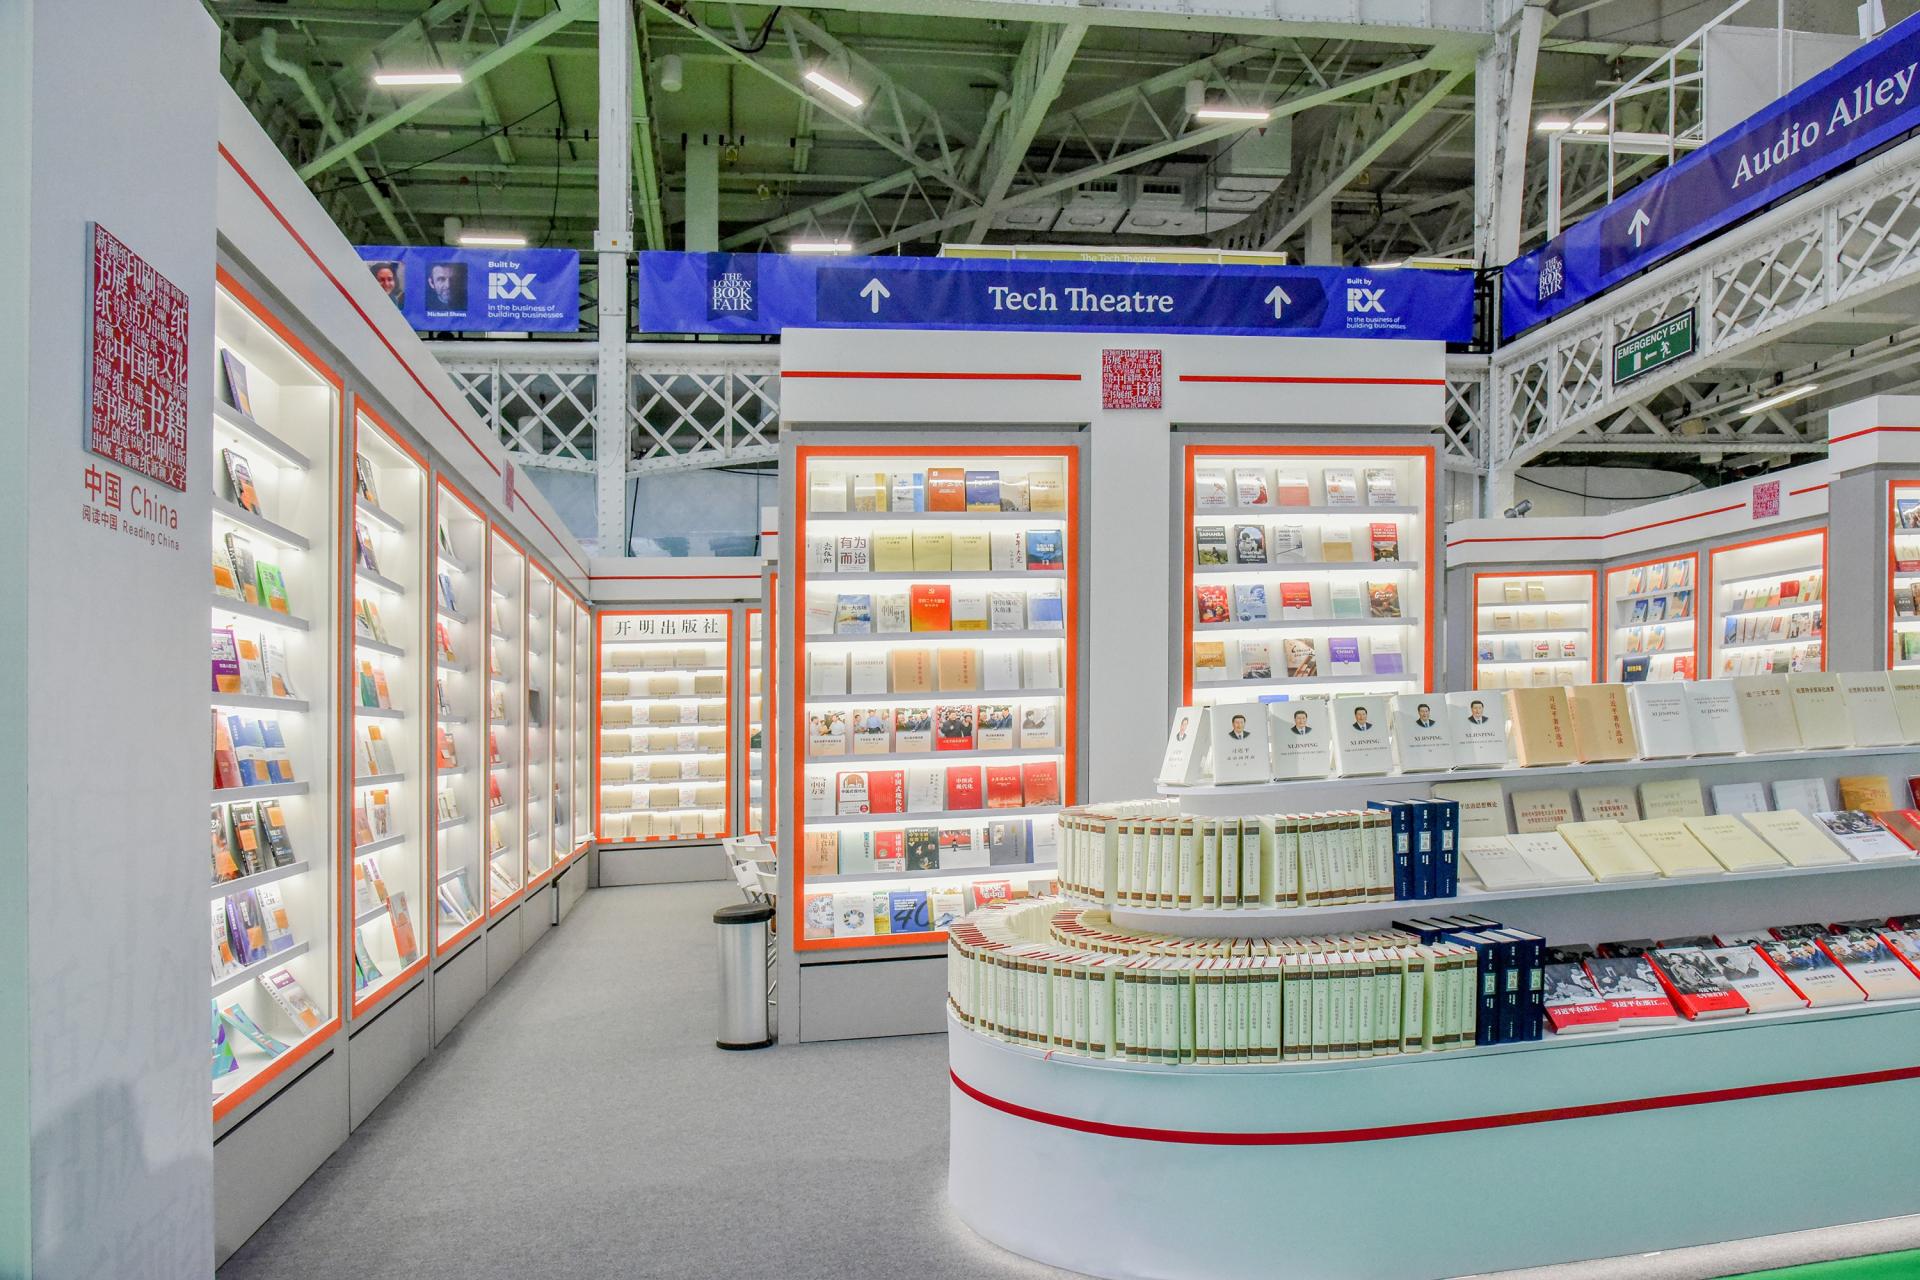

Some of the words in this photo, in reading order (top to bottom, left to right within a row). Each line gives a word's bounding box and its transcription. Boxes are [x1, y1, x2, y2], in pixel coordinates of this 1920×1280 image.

[1731, 121, 1820, 189] Audio
[1826, 62, 1919, 136] Alley
[509, 261, 520, 270] by
[488, 272, 537, 300] RX
[713, 280, 751, 288] LONDON
[722, 272, 742, 281] THE
[1363, 278, 1372, 286] by
[713, 287, 752, 299] BOOK
[988, 286, 1058, 311] Tech
[1065, 287, 1174, 313] Theatre
[1347, 288, 1386, 313] RX
[488, 311, 520, 319] building
[713, 298, 752, 311] FAIR
[1617, 328, 1667, 360] EMERGENCY
[1669, 318, 1689, 335] EXIT
[114, 337, 148, 388] 中国
[145, 384, 187, 449] 书籍
[85, 464, 121, 512] 中国
[131, 485, 178, 530] China
[82, 504, 118, 531] 阅读中国
[122, 520, 156, 546] Reading
[157, 532, 179, 551] China
[840, 536, 867, 549] 有为
[840, 551, 867, 565] 而治
[615, 618, 719, 636] 开明出版社
[895, 772, 903, 813] 中国式现代化
